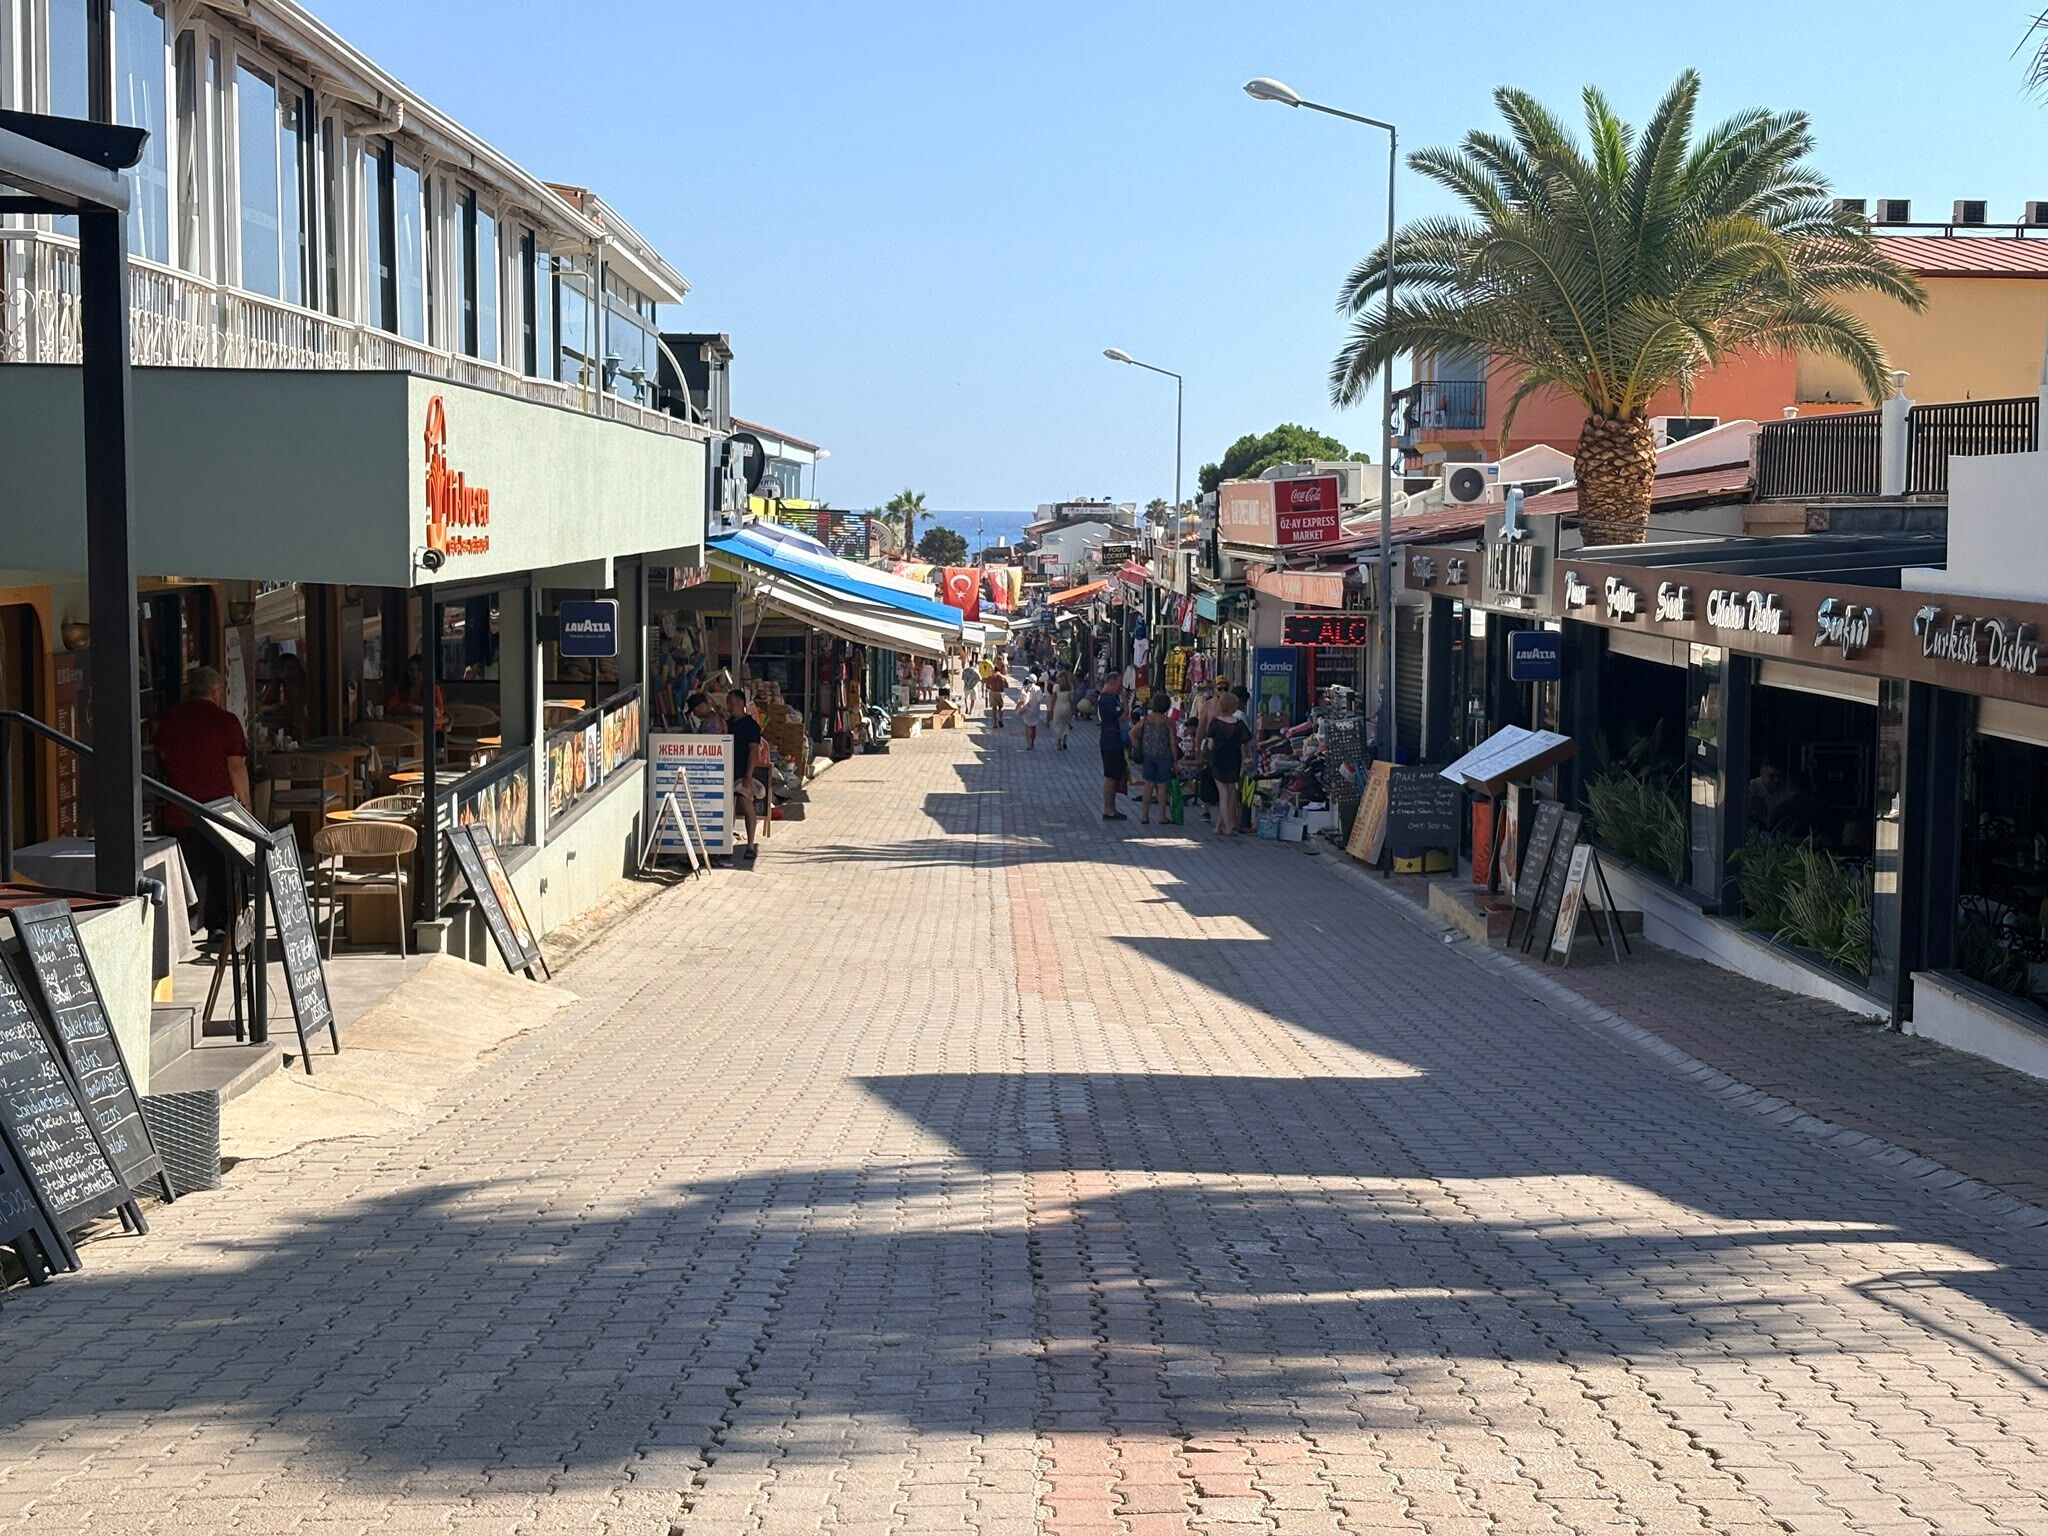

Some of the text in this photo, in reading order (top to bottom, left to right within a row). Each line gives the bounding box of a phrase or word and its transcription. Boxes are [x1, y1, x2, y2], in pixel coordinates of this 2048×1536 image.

[1280, 516, 1335, 529] ÖZ-AY EXPRESS
[1292, 529, 1324, 541] MARKET
[565, 619, 611, 632] LAVAZZA
[1707, 589, 1745, 630] Chicken
[1747, 590, 1782, 635] Dishes
[1913, 605, 1978, 664] Turkish
[1984, 618, 2038, 674] Dishes
[1516, 647, 1556, 660] LAVAZZA
[1260, 661, 1292, 671] damla
[658, 744, 723, 756] ЖЕНЯ И САША
